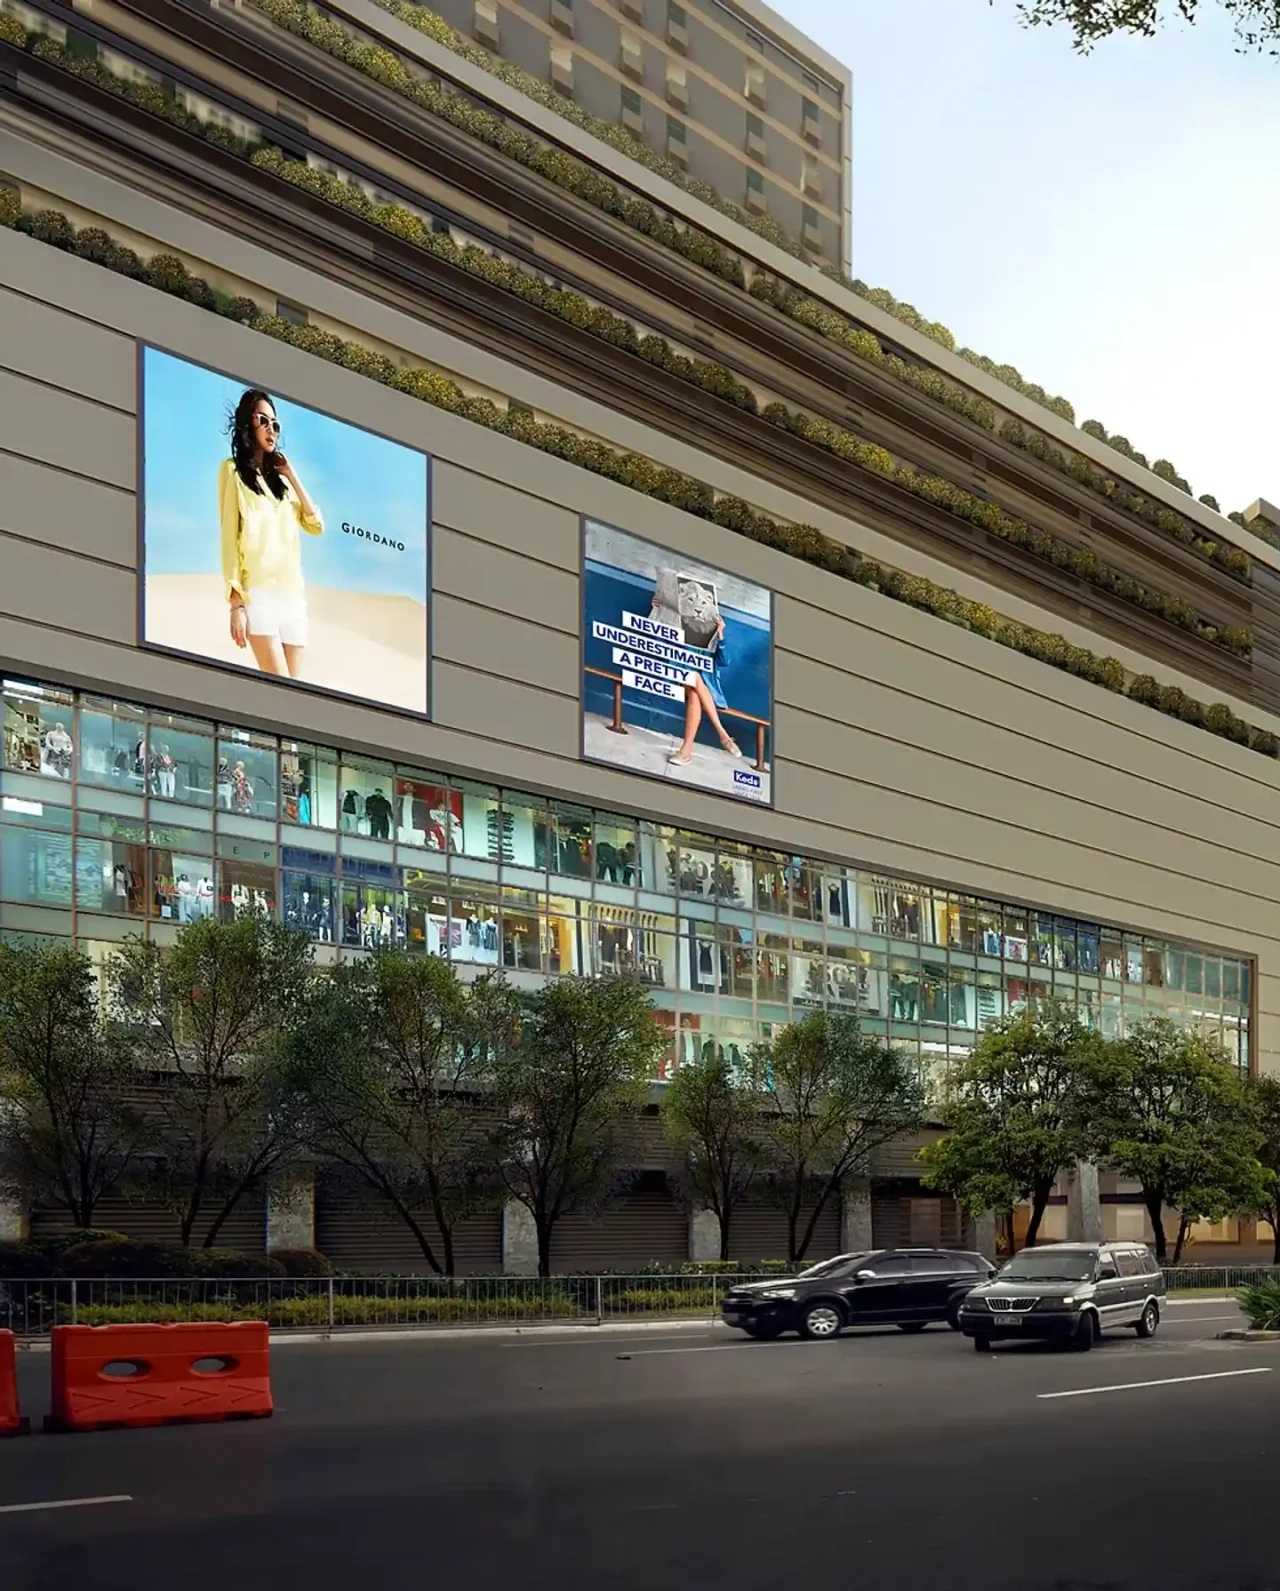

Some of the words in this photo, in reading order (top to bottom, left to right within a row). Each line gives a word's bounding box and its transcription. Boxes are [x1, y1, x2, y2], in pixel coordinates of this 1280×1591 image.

[341, 522, 405, 551] GIORDANO
[630, 616, 679, 641] NEVER
[596, 625, 712, 670] UNDERESTIMATE
[619, 652, 631, 665] A
[634, 656, 689, 682] PRETTY
[634, 675, 676, 698] FACE.
[735, 772, 759, 786] Keds
